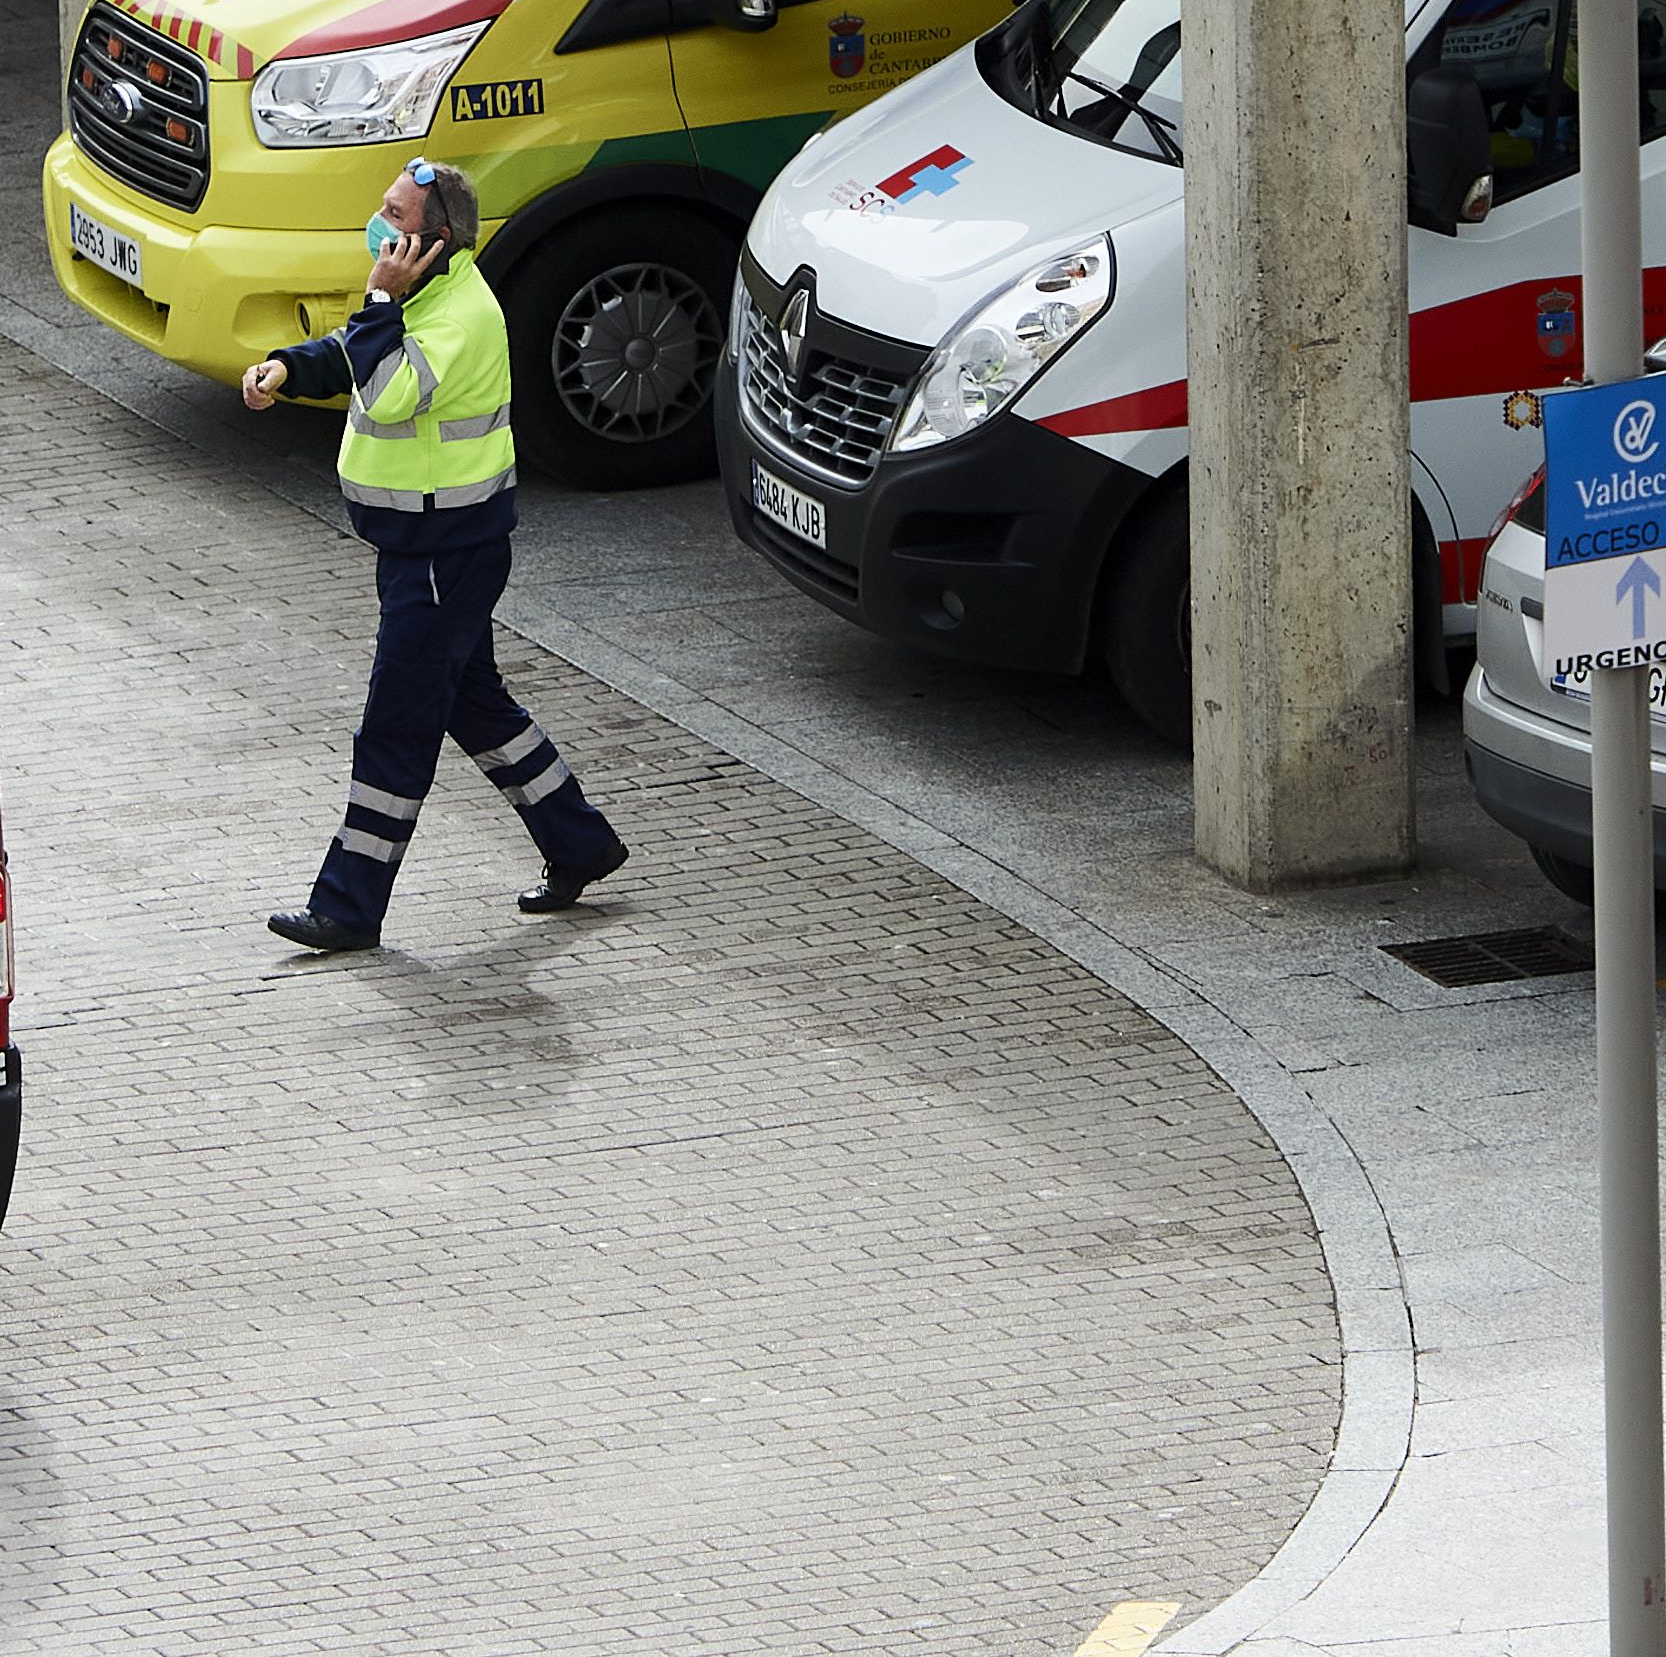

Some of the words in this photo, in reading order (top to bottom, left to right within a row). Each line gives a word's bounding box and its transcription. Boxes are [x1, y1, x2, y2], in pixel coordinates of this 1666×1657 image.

[870, 27, 951, 45] GOBIERNO
[870, 49, 885, 60] de
[455, 82, 540, 120] A-1011
[110, 235, 137, 276] JWG
[760, 472, 788, 522] 6484
[792, 494, 820, 540] KJB
[1557, 520, 1660, 563] ACCESO
